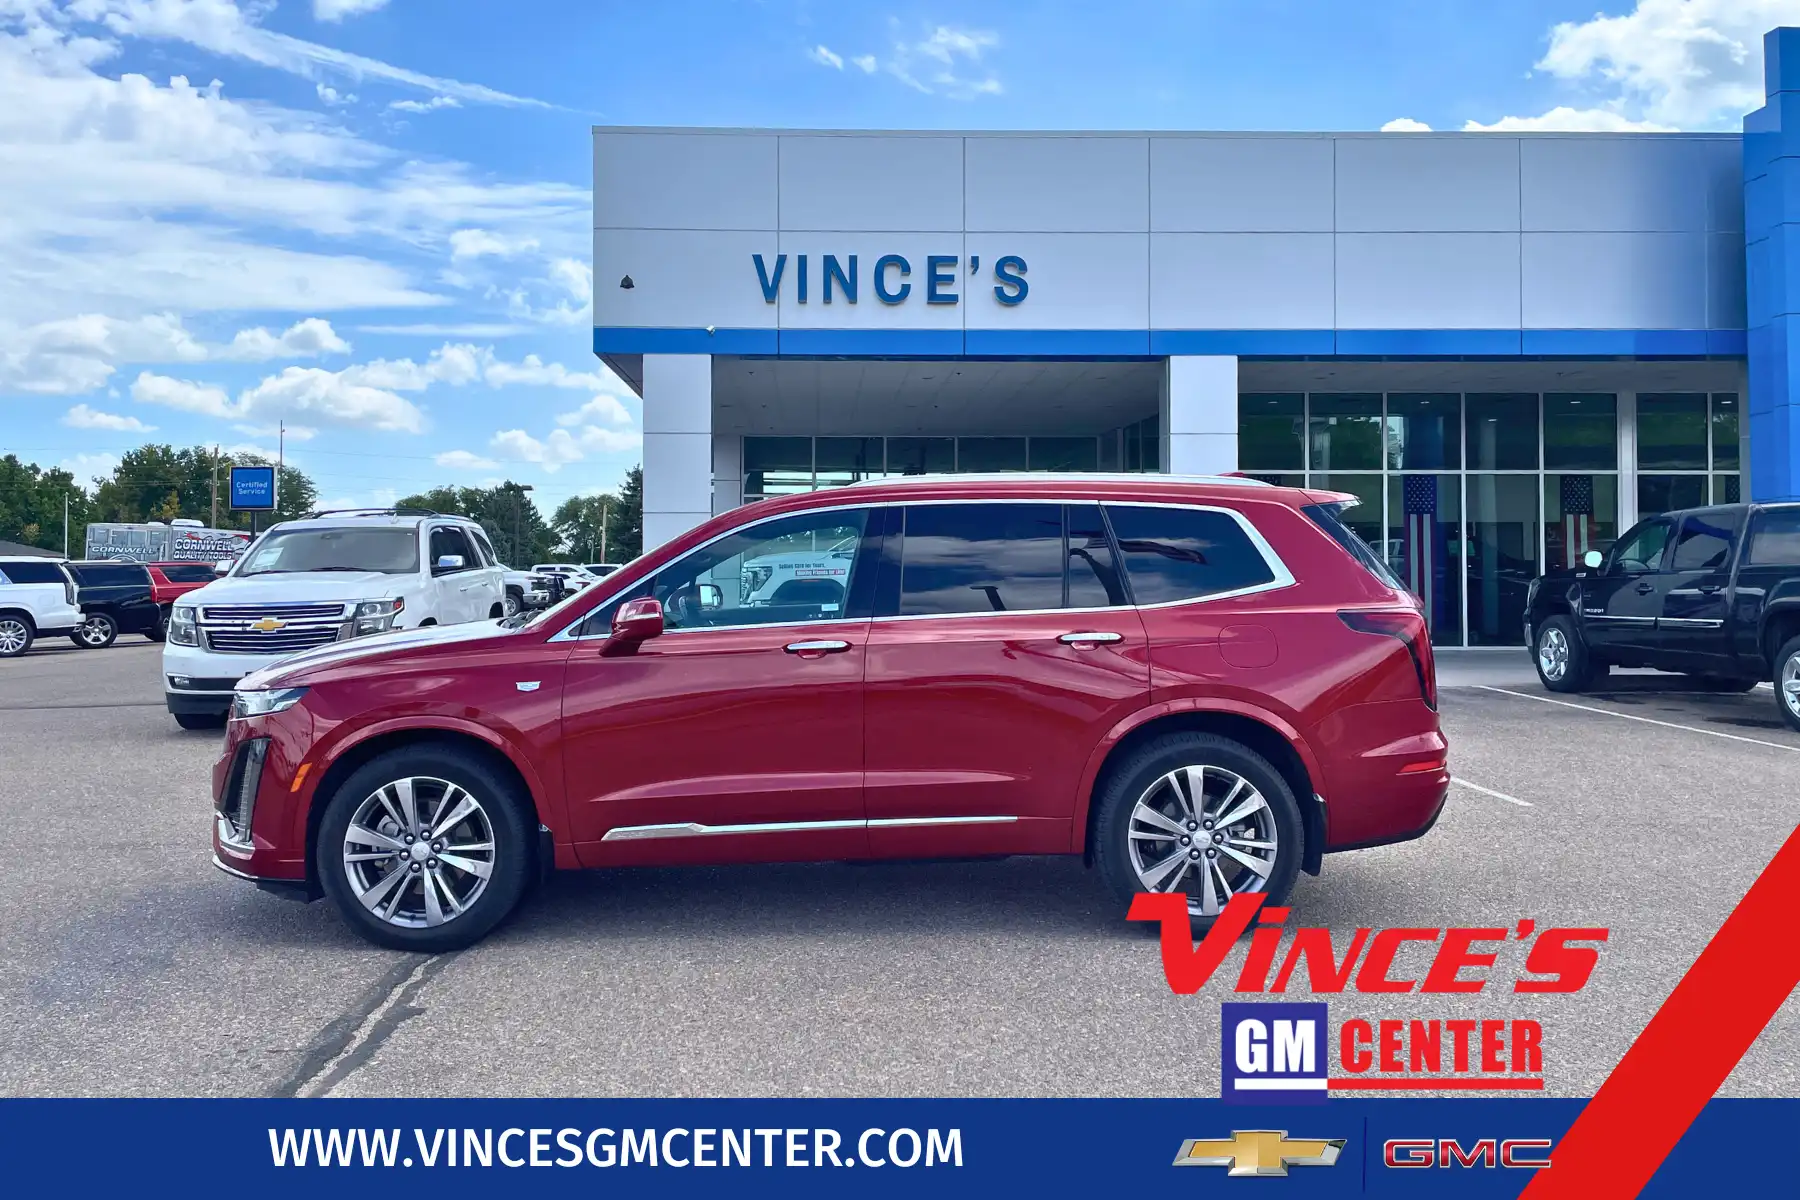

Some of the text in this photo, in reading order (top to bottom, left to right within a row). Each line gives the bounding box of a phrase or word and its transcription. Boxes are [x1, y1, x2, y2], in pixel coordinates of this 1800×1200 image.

[752, 254, 1029, 306] VINCE'S
[91, 545, 154, 555] CORNWELL
[174, 538, 233, 552] CORNWELL
[173, 551, 232, 560] QUALITY TOOLS
